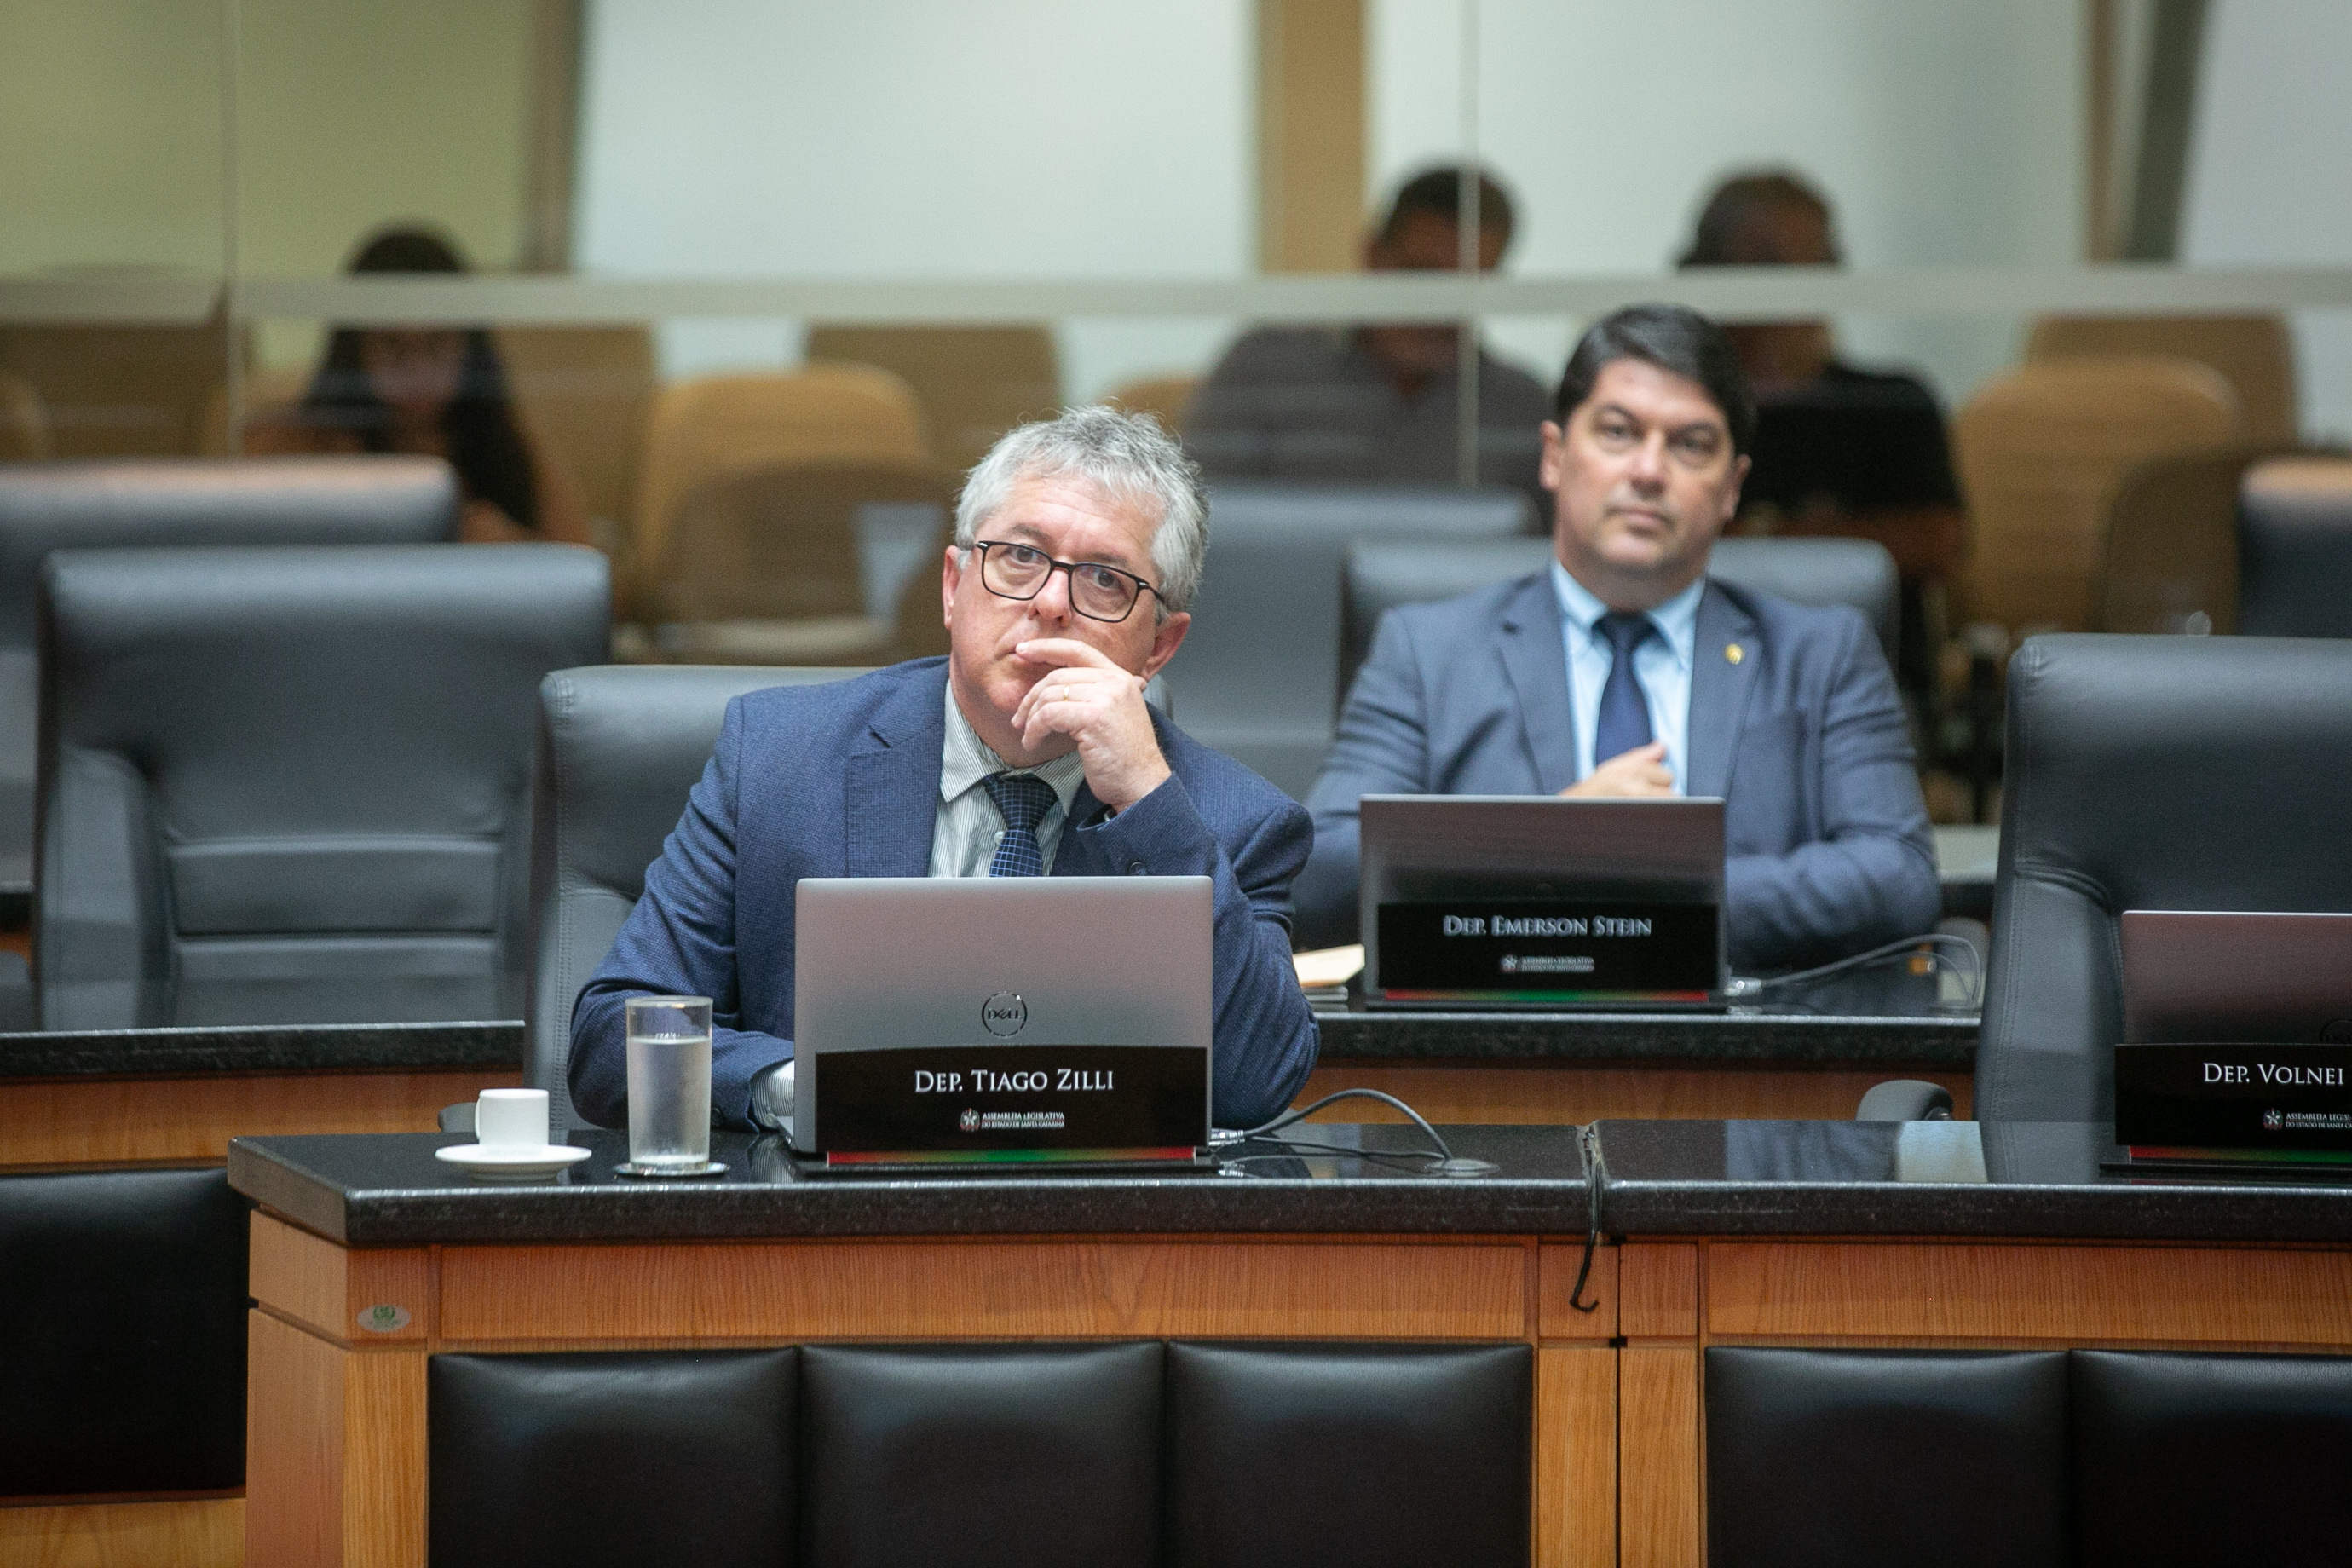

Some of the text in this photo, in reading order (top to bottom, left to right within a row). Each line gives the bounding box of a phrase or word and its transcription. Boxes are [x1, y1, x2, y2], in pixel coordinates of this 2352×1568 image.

[1491, 915, 1588, 936] EMERSON
[1592, 915, 1652, 936] STEIN
[988, 1008, 1022, 1019] DELL
[914, 1069, 1114, 1092] DEP. TIAGO ZILLI
[2203, 1063, 2344, 1085] DEP. VOLNEI
